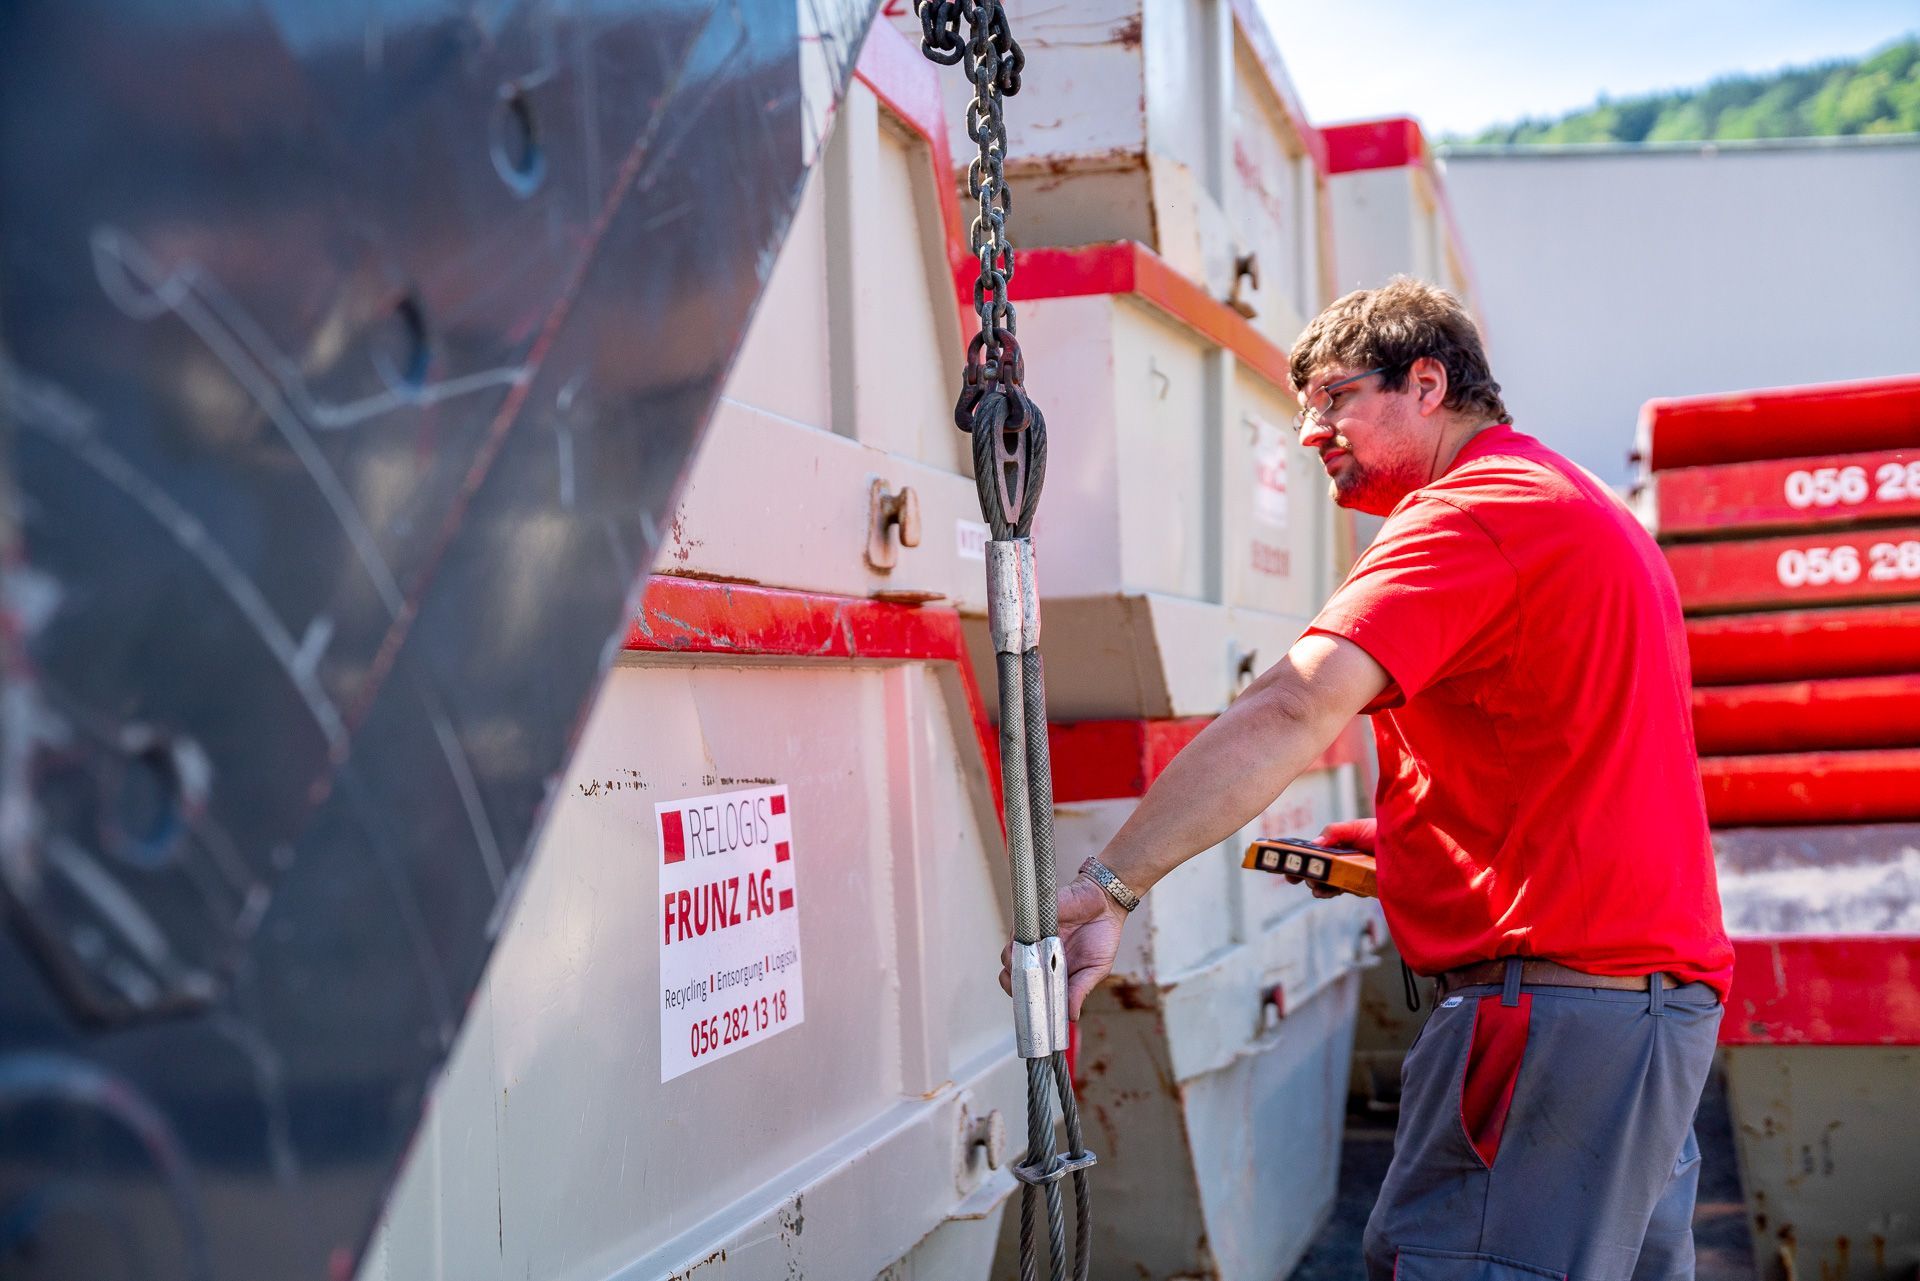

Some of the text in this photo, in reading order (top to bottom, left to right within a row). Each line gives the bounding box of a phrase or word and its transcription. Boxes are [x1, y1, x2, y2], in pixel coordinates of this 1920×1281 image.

[1785, 466, 1869, 509] 056
[1777, 540, 1920, 588] 056 28
[688, 797, 769, 859] RELOGIS
[664, 868, 774, 945] FRUNZ AG
[665, 946, 798, 1010] Recycling Entsorgung Logistik
[691, 989, 786, 1057] 056 282 13 18
